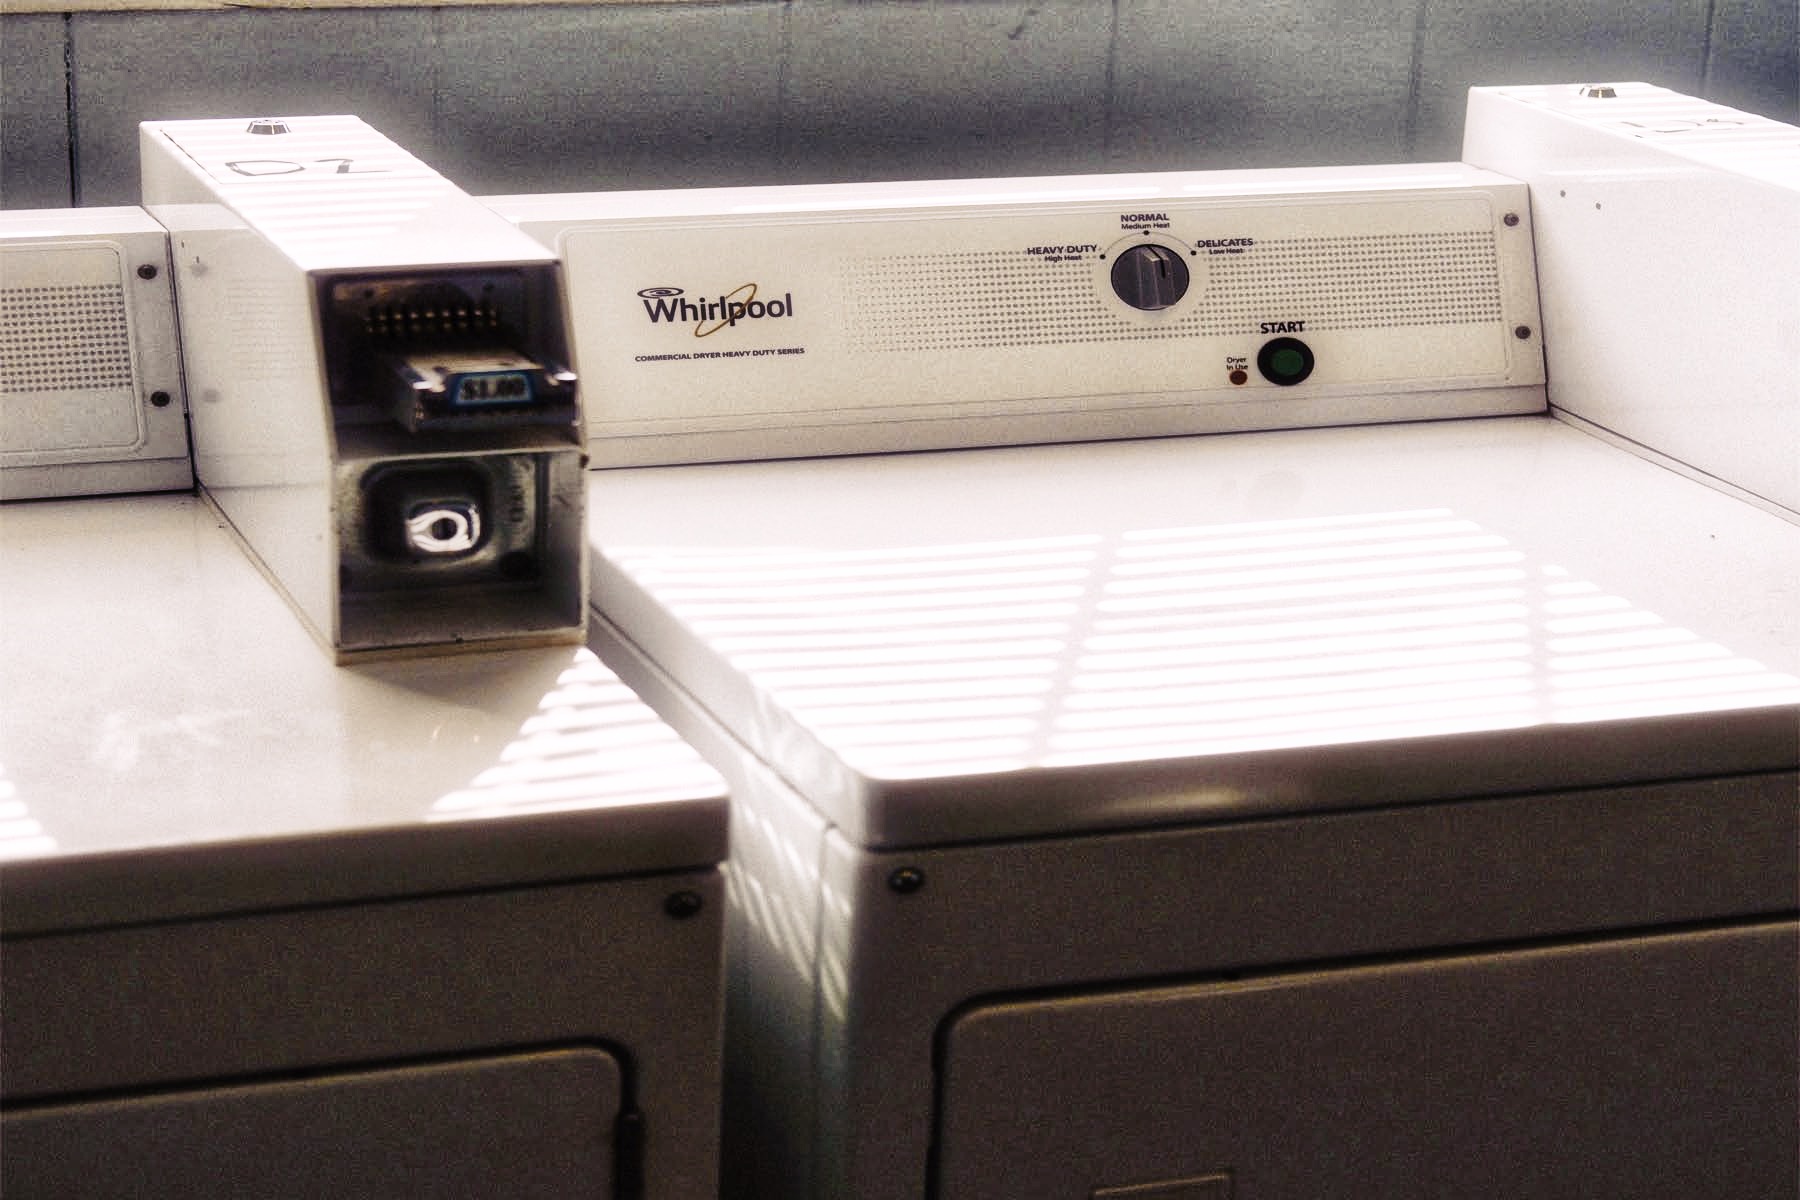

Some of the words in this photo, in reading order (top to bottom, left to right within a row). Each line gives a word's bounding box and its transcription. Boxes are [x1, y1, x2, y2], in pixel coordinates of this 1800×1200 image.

[1121, 213, 1170, 222] NORMAL
[1121, 222, 1151, 230] Medium
[1197, 238, 1254, 249] DELICATES
[1027, 246, 1065, 255] HEAVY
[1066, 244, 1097, 254] DUTY
[1045, 255, 1063, 263] High
[1064, 254, 1082, 262] Heat
[643, 293, 793, 327] Whirlpool
[1260, 320, 1305, 334] START
[635, 353, 692, 362] COMMERCIAL
[693, 352, 721, 360] DRYER
[722, 350, 751, 358] HEAVY
[752, 349, 776, 357] DUTY
[777, 347, 805, 356] SERIES
[1226, 356, 1247, 364] Dryer
[1235, 363, 1249, 371] Use
